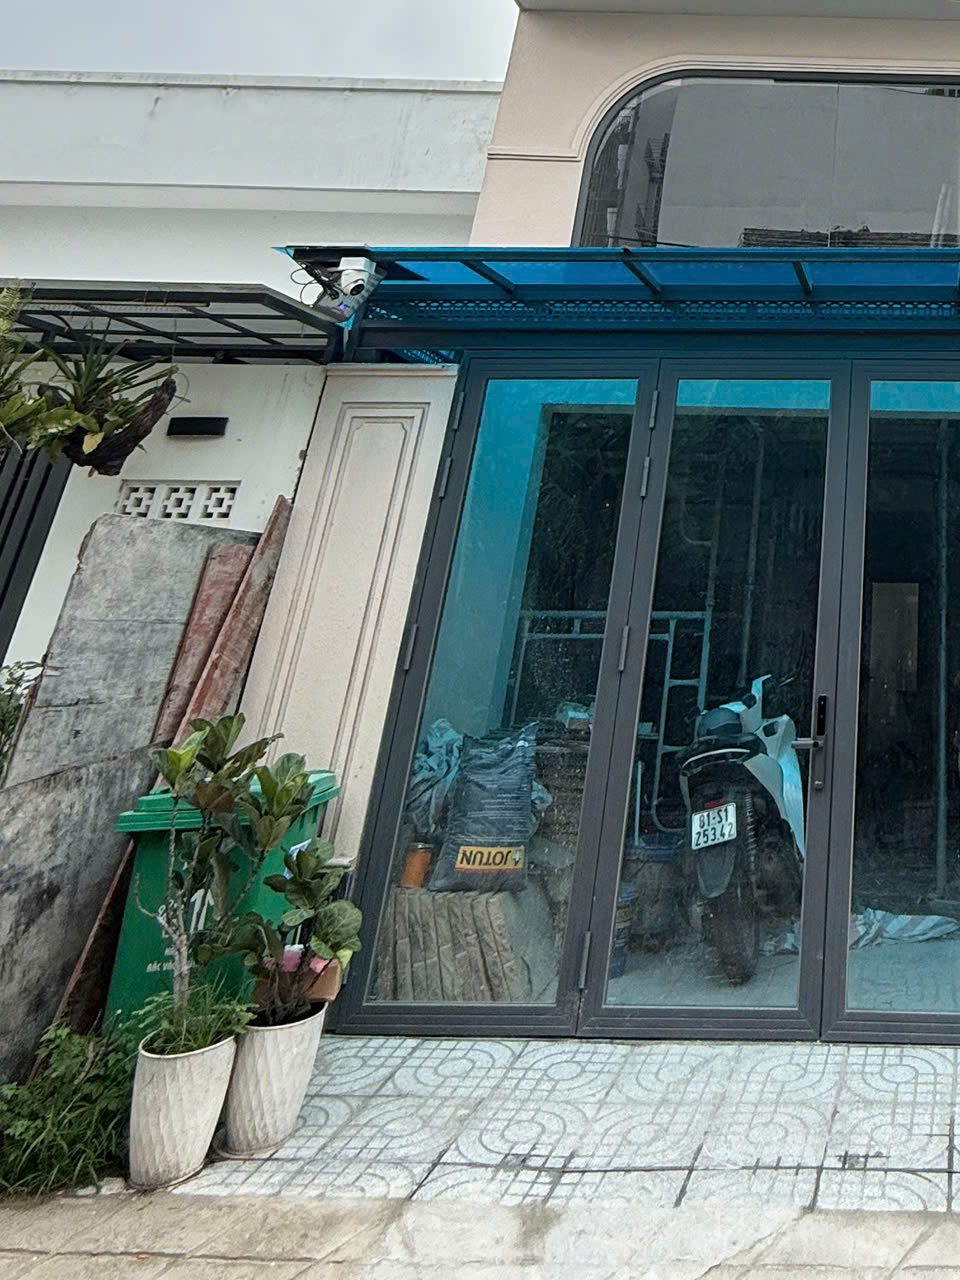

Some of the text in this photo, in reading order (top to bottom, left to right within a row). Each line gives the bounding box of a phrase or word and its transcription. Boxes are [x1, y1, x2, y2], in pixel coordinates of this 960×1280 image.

[699, 807, 728, 829] 81-S1
[695, 822, 735, 847] 253.42
[459, 849, 512, 866] JOTUN
